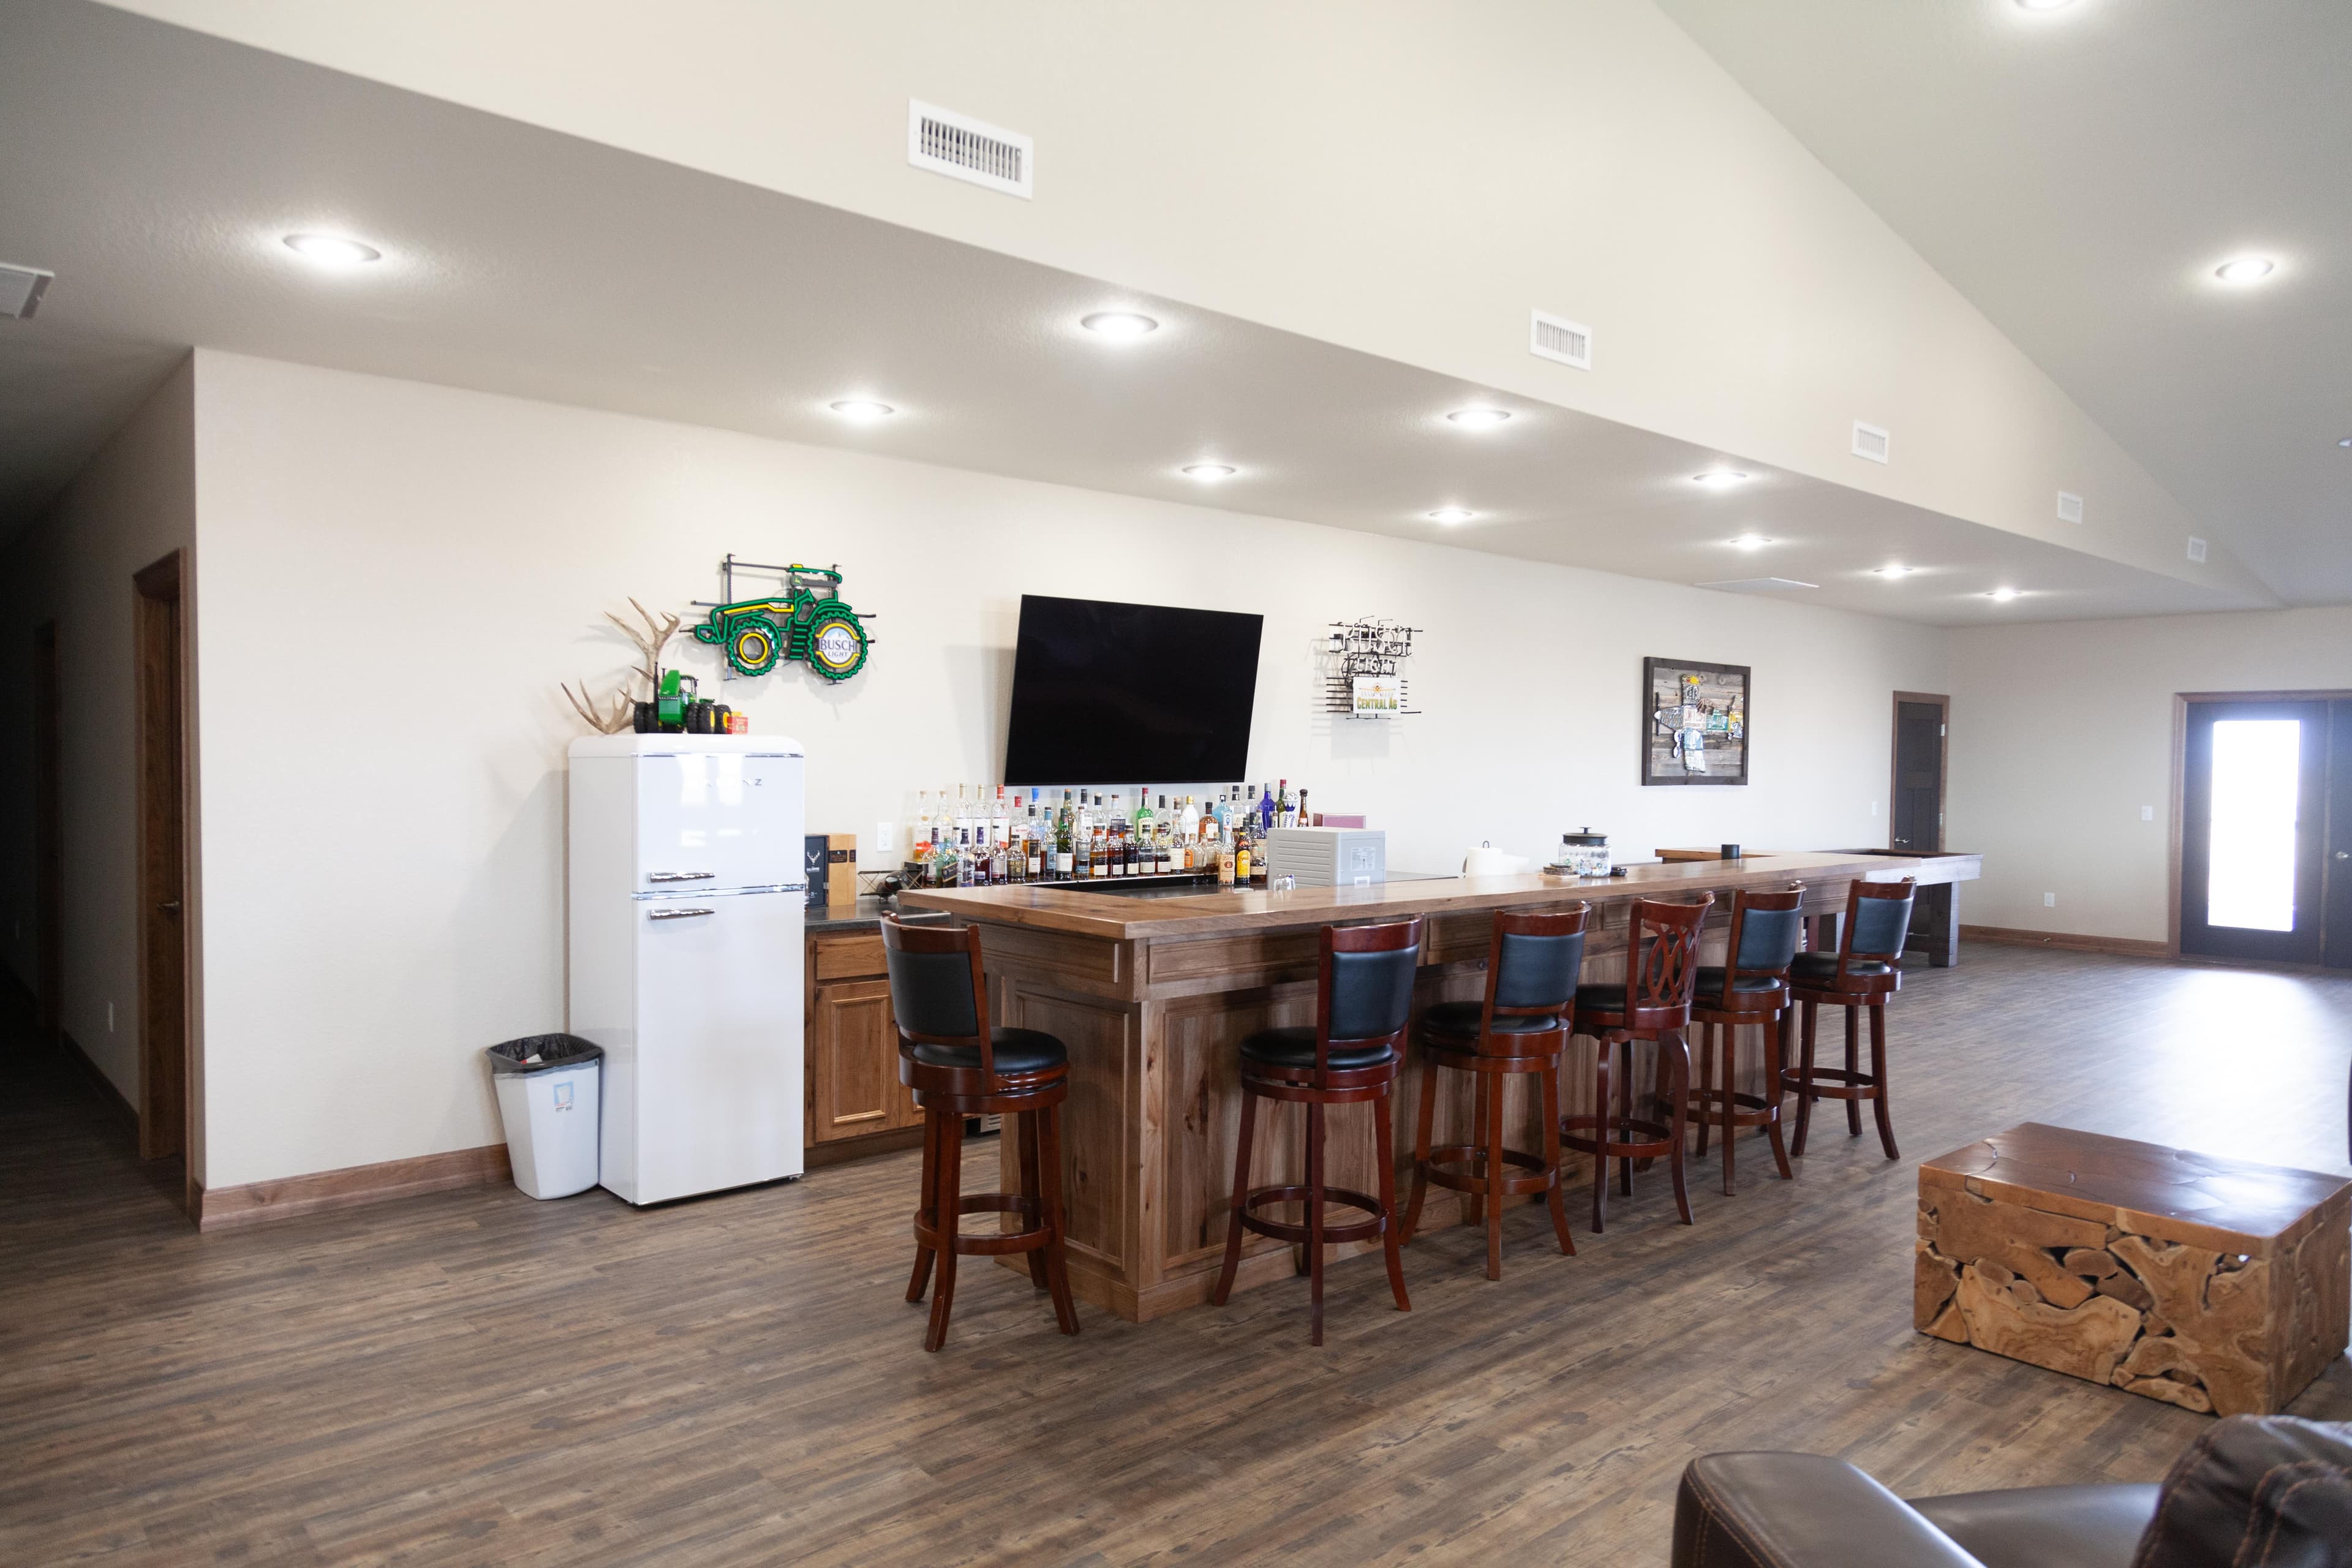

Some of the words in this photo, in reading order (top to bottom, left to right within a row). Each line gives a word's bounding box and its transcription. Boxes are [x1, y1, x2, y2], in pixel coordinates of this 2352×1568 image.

[820, 639, 855, 652] BUSCH
[1342, 624, 1414, 657] BUSCH
[1357, 657, 1396, 674] LIGHT
[1357, 696, 1387, 709] CENTRAL
